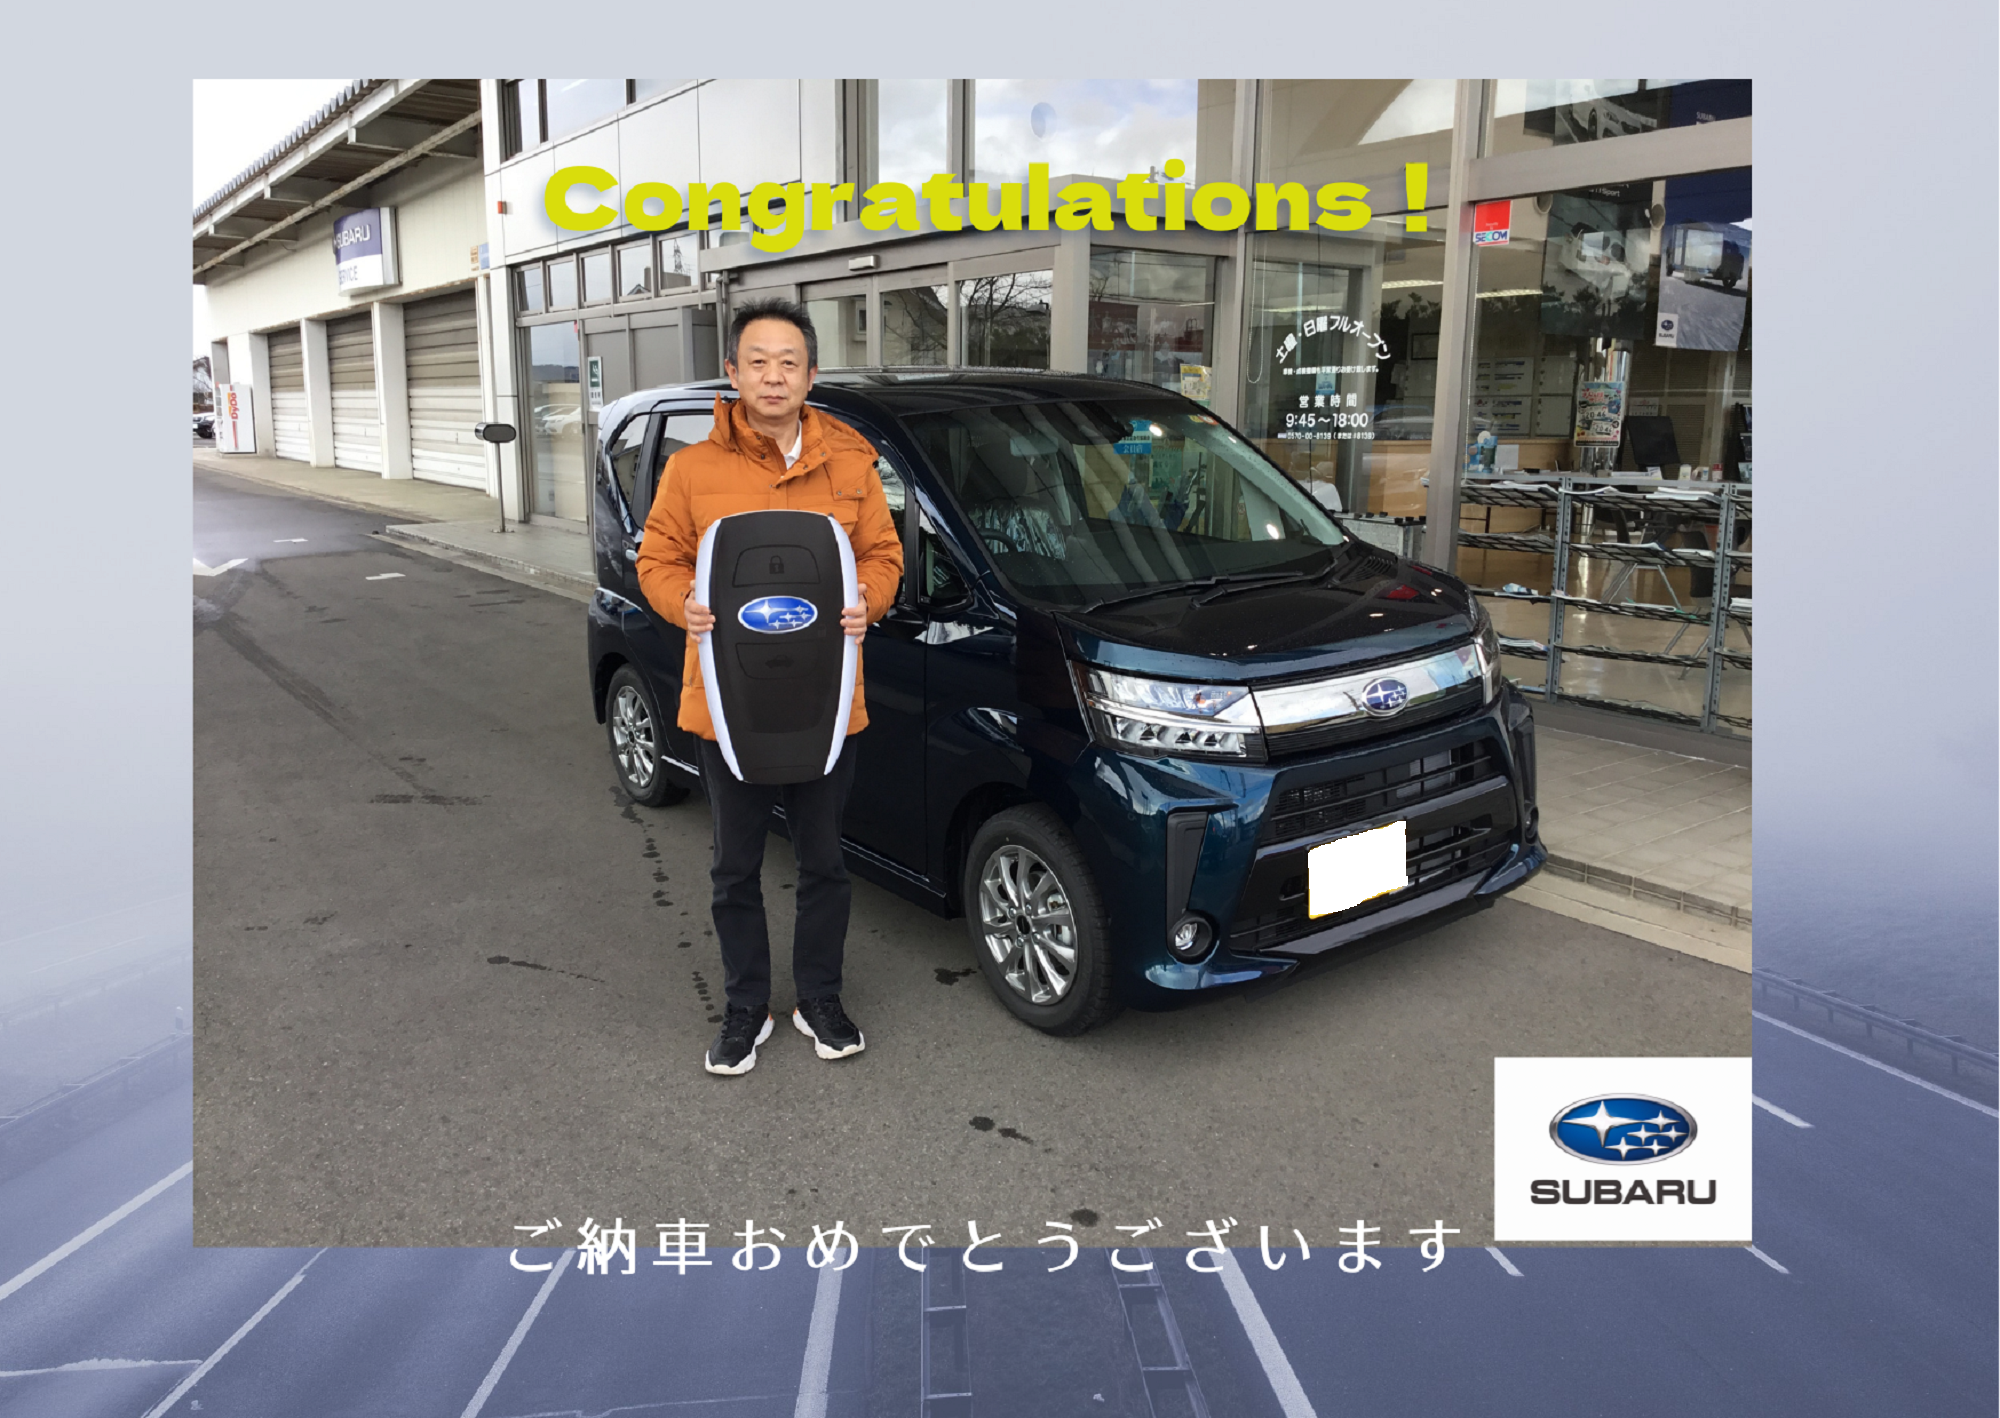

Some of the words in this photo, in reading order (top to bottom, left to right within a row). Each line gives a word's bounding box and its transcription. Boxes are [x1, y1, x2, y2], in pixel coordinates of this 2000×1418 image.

[336, 224, 371, 249] SUBARU
[1475, 230, 1508, 242] SECOM
[230, 392, 240, 420] DyDo
[1299, 393, 1358, 408] 営業時間
